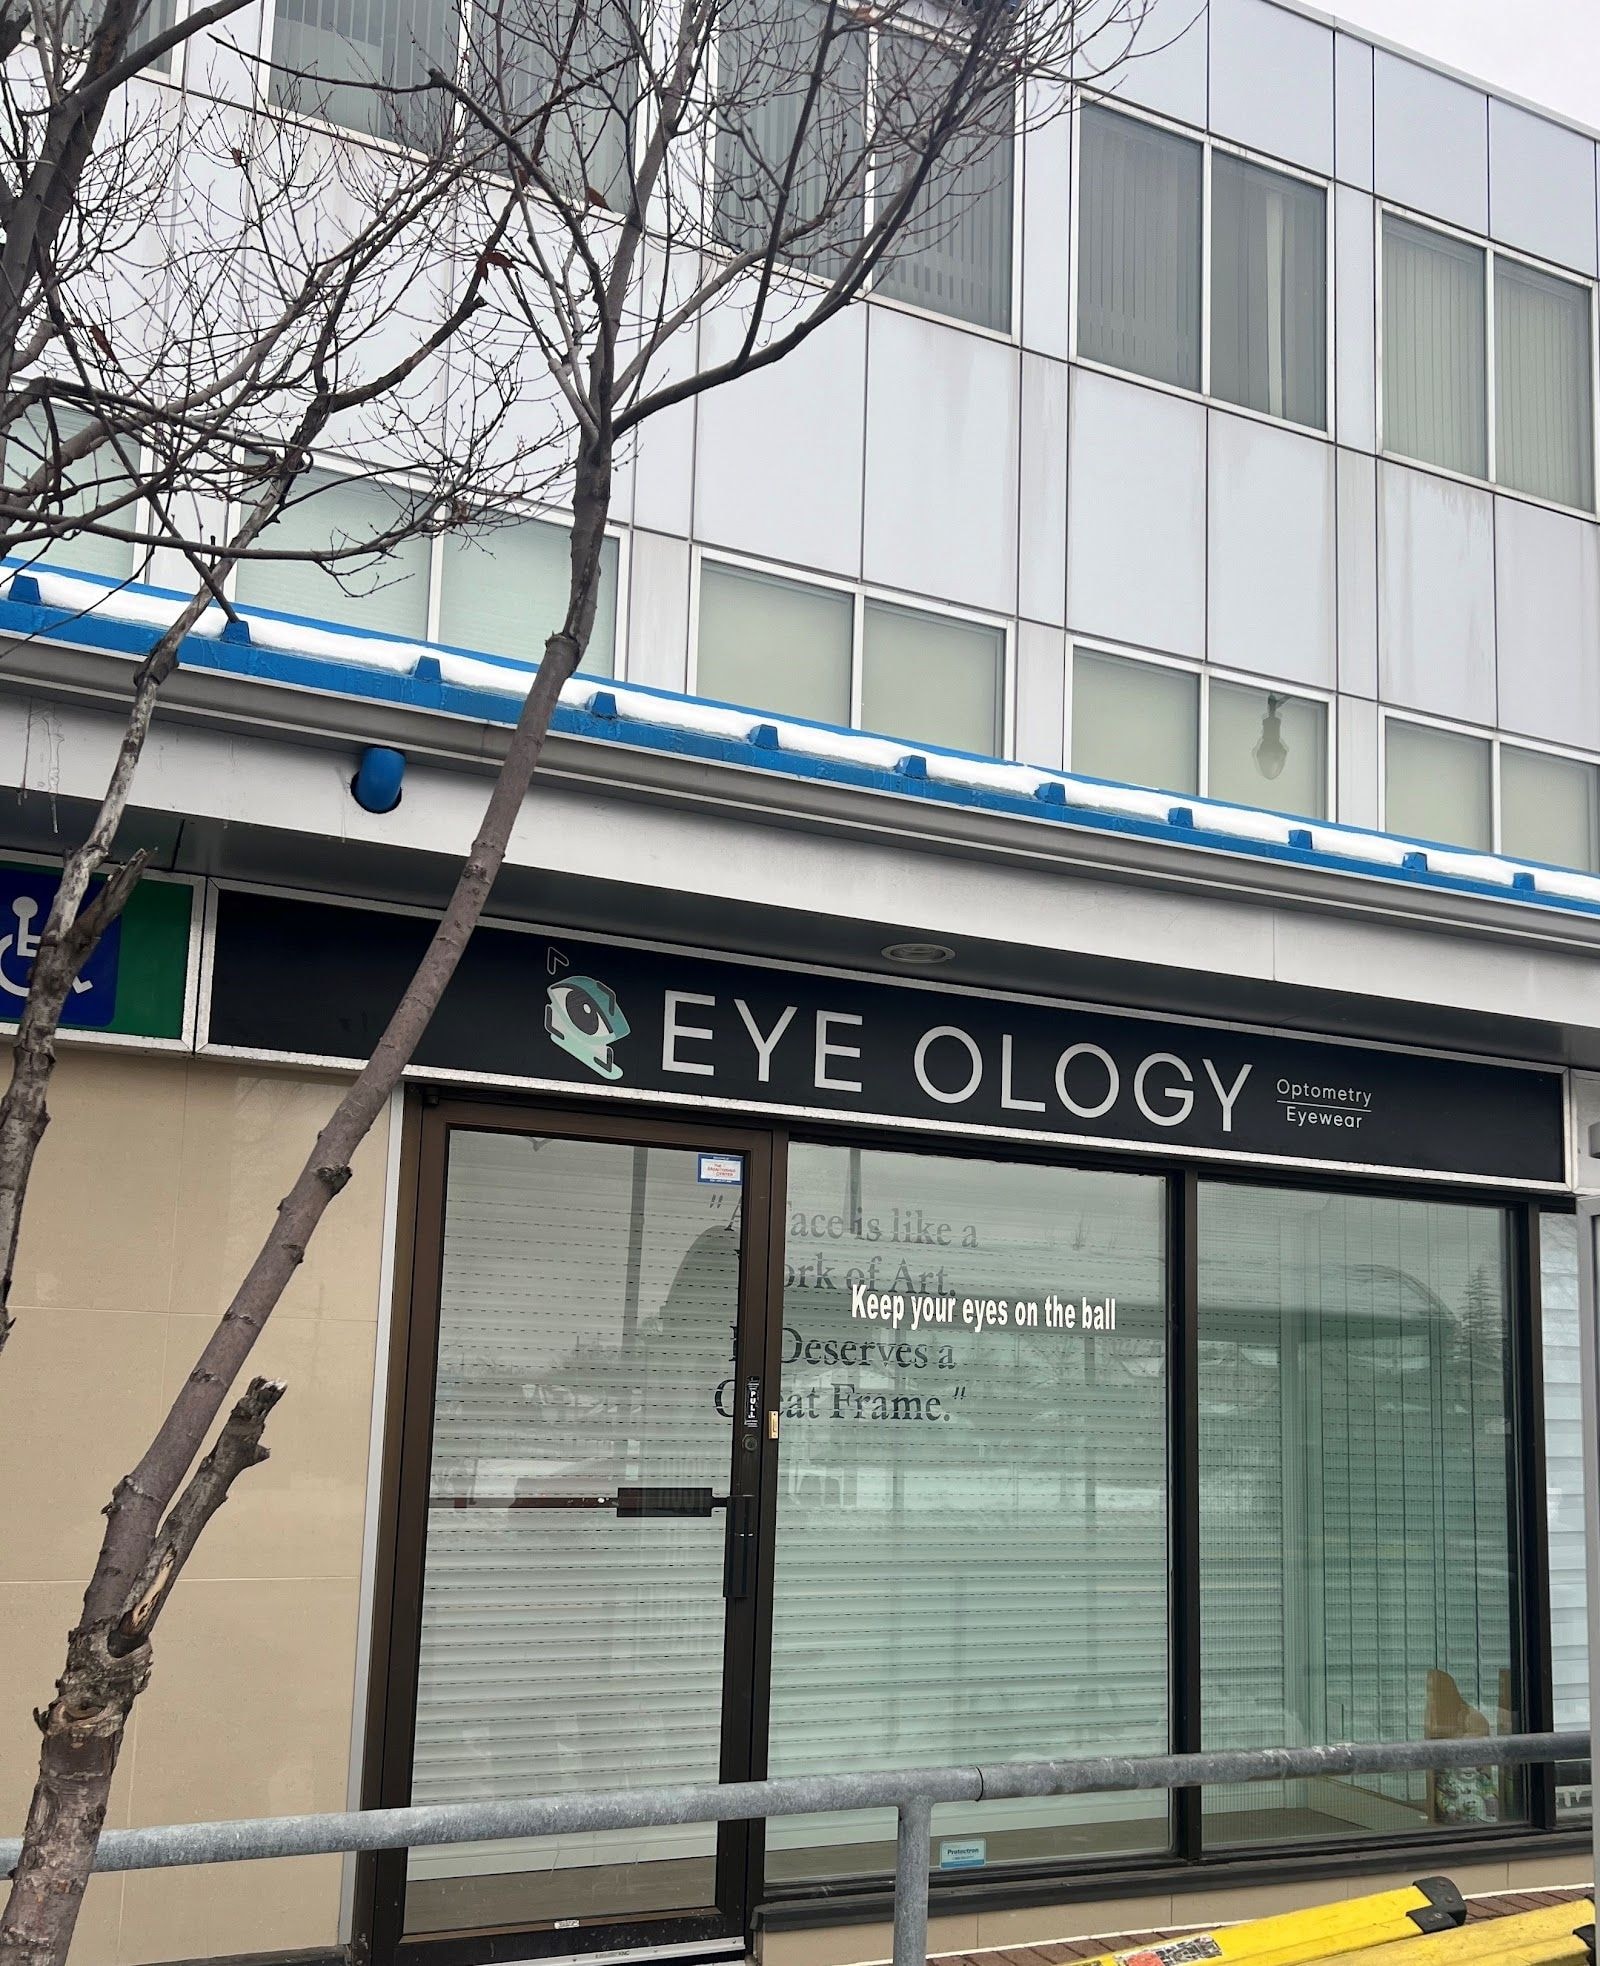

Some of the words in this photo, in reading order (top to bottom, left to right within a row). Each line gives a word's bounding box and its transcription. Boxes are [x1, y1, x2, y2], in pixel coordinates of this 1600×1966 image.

[662, 989, 864, 1092] EYE
[914, 1025, 1253, 1132] OLOGY
[1276, 1078, 1372, 1107] Optometry
[1286, 1105, 1362, 1128] Eyewear
[786, 1201, 844, 1239] ace
[853, 1206, 882, 1242] is
[890, 1207, 952, 1246] like
[961, 1224, 979, 1248] a
[845, 1255, 882, 1293] of
[888, 1257, 956, 1297] Art.
[851, 1284, 905, 1329] Keep
[910, 1295, 957, 1331] your
[962, 1298, 1008, 1333] eyes
[1015, 1300, 1038, 1327] on
[1045, 1295, 1075, 1329] the
[1082, 1296, 1116, 1330] ball
[781, 1327, 928, 1369] Deserves
[938, 1344, 956, 1370] a
[747, 1390, 757, 1419] PULL
